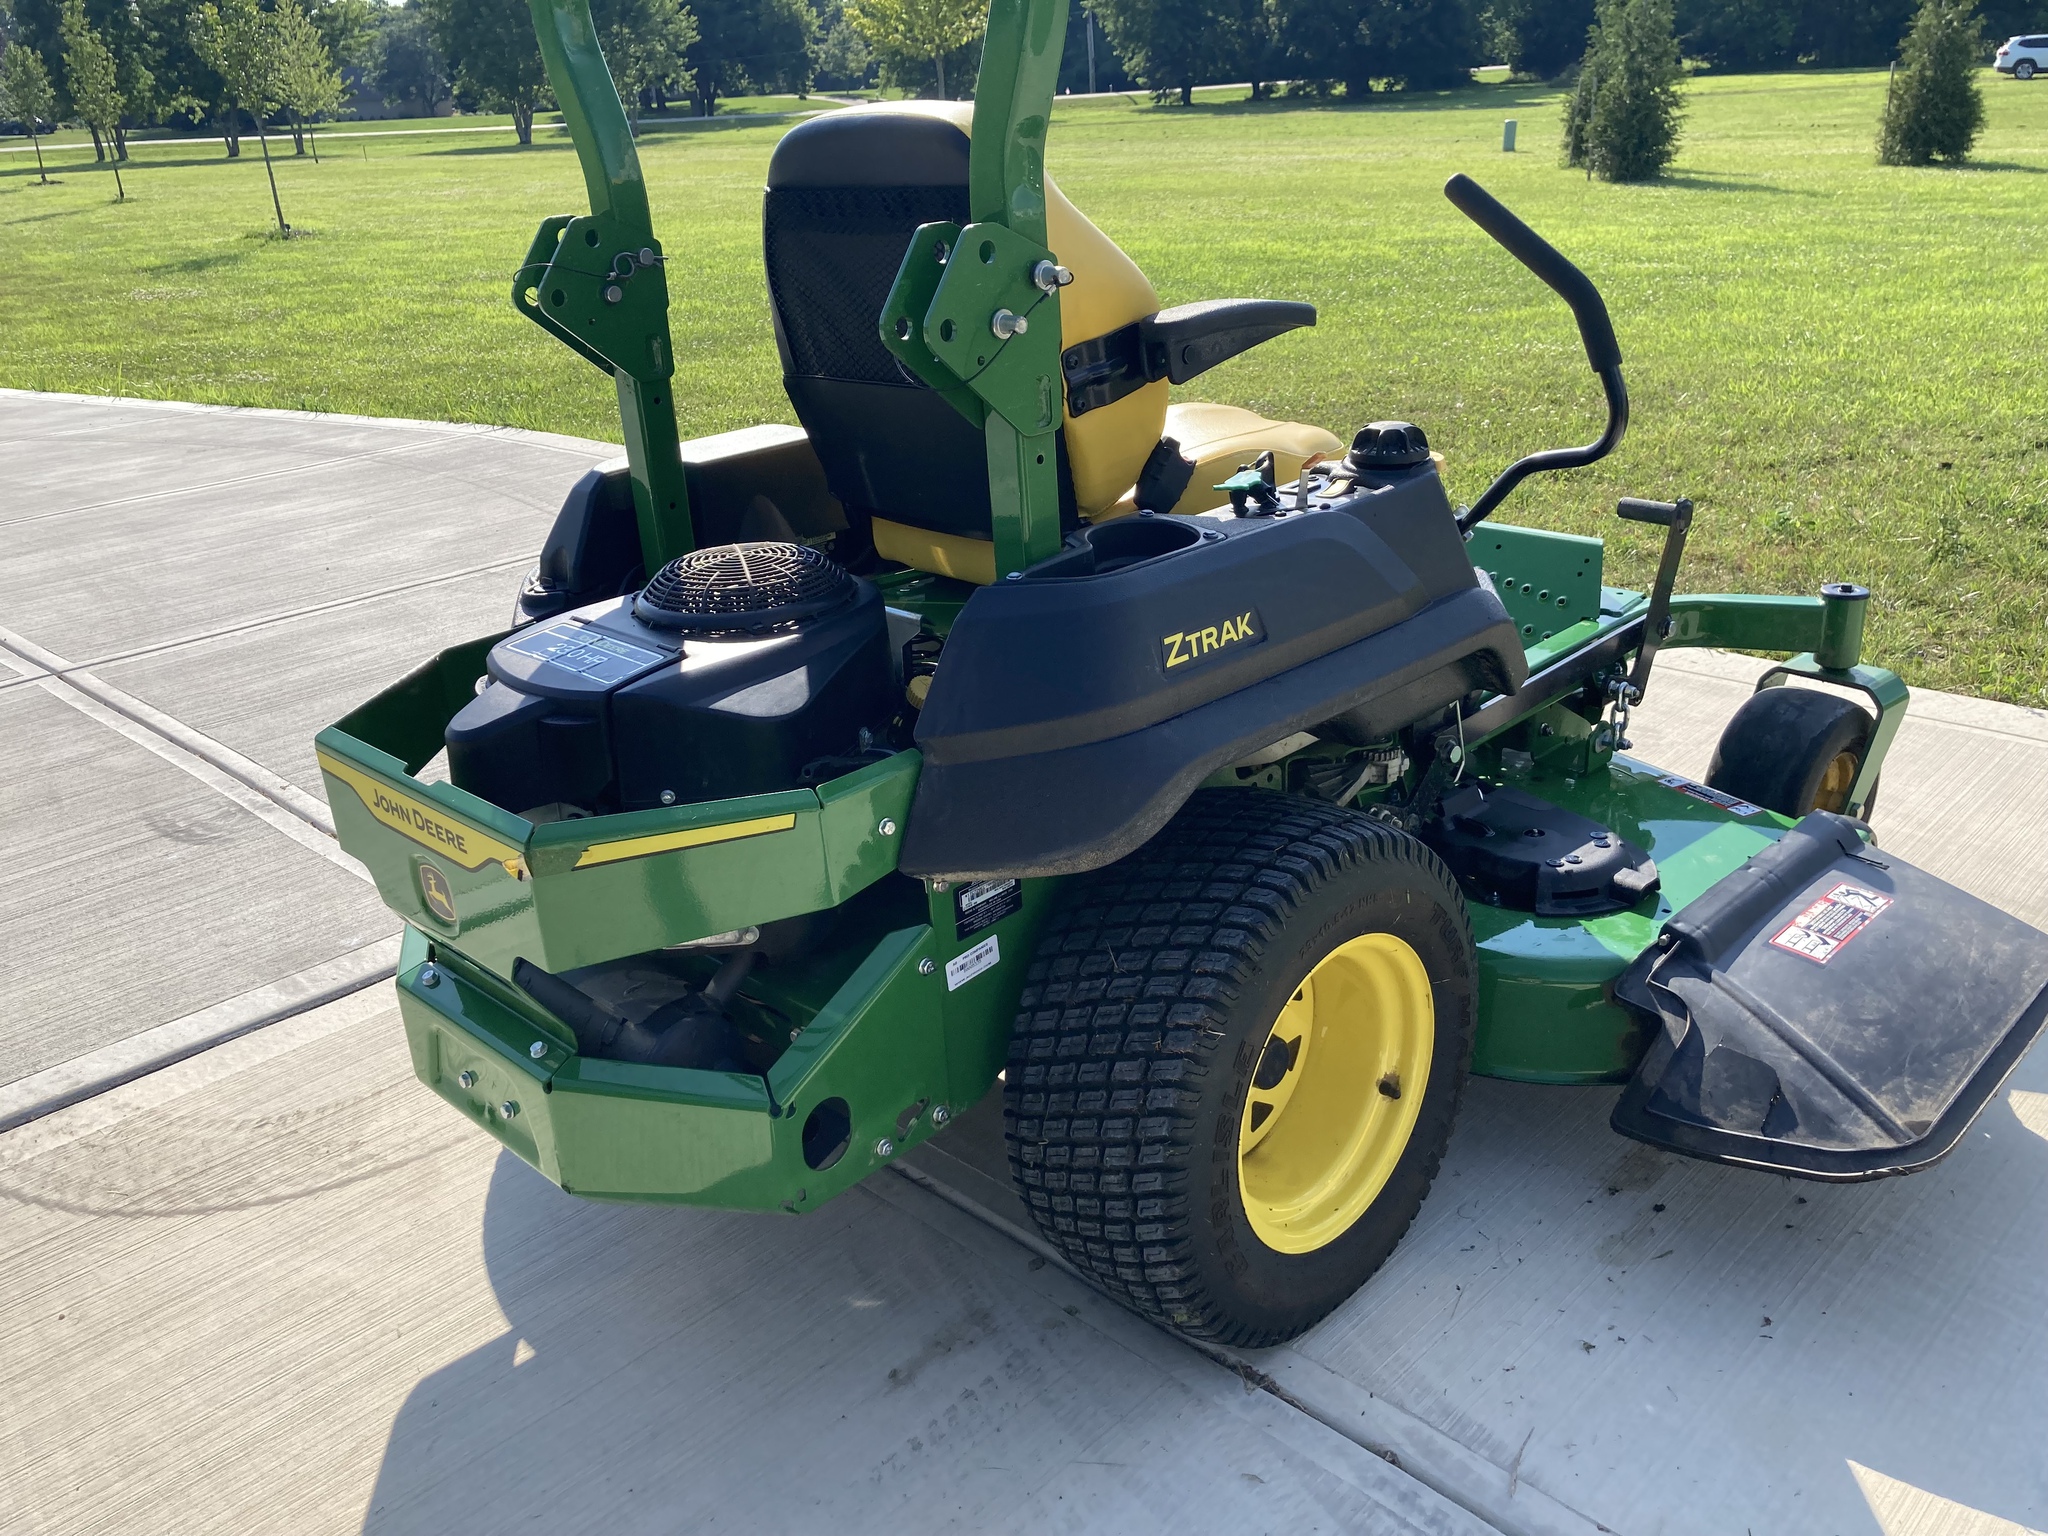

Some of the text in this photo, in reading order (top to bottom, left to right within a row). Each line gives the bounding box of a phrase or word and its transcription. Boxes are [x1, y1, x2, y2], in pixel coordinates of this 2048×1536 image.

[576, 652, 608, 664] HP
[1163, 611, 1254, 668] ZTRAK
[373, 788, 468, 854] JOHN DEERE
[1211, 1037, 1255, 1278] CARLISLE
